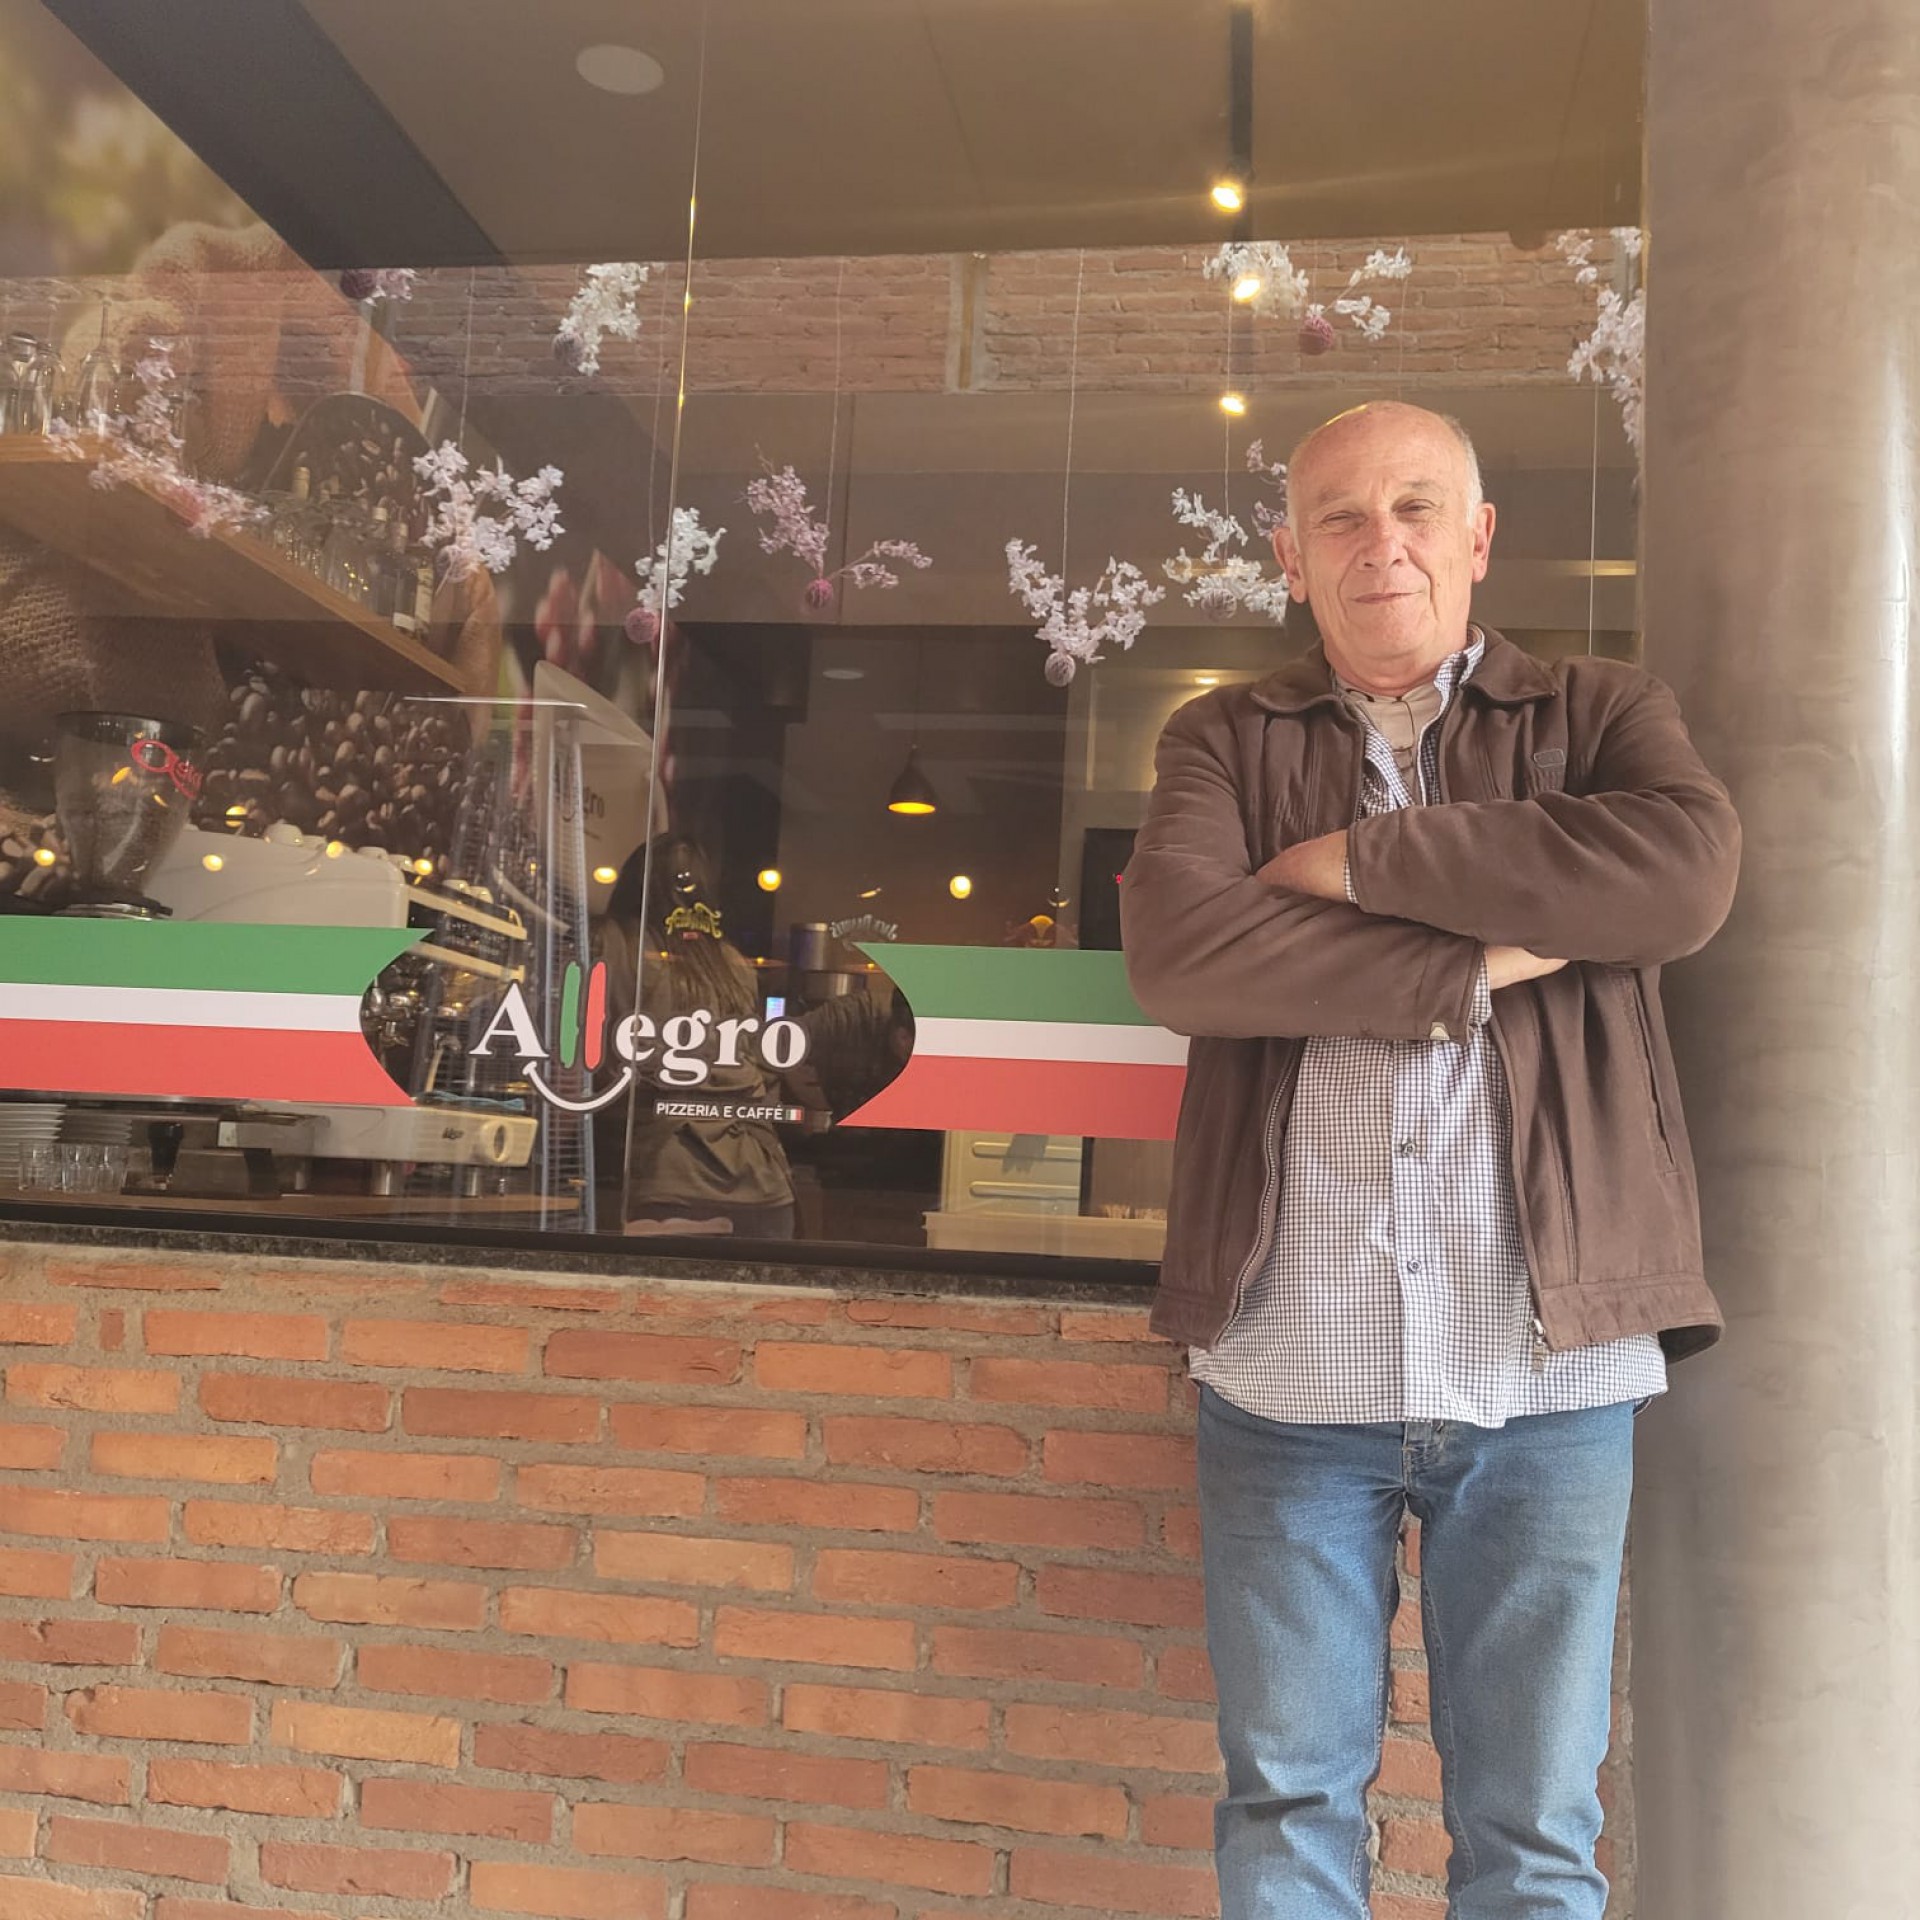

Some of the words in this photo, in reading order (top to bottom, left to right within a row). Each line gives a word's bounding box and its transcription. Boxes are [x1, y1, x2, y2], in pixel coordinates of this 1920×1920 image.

[468, 961, 807, 1086] Allegro
[655, 1102, 720, 1118] PIZZERIA
[723, 1105, 733, 1118] E
